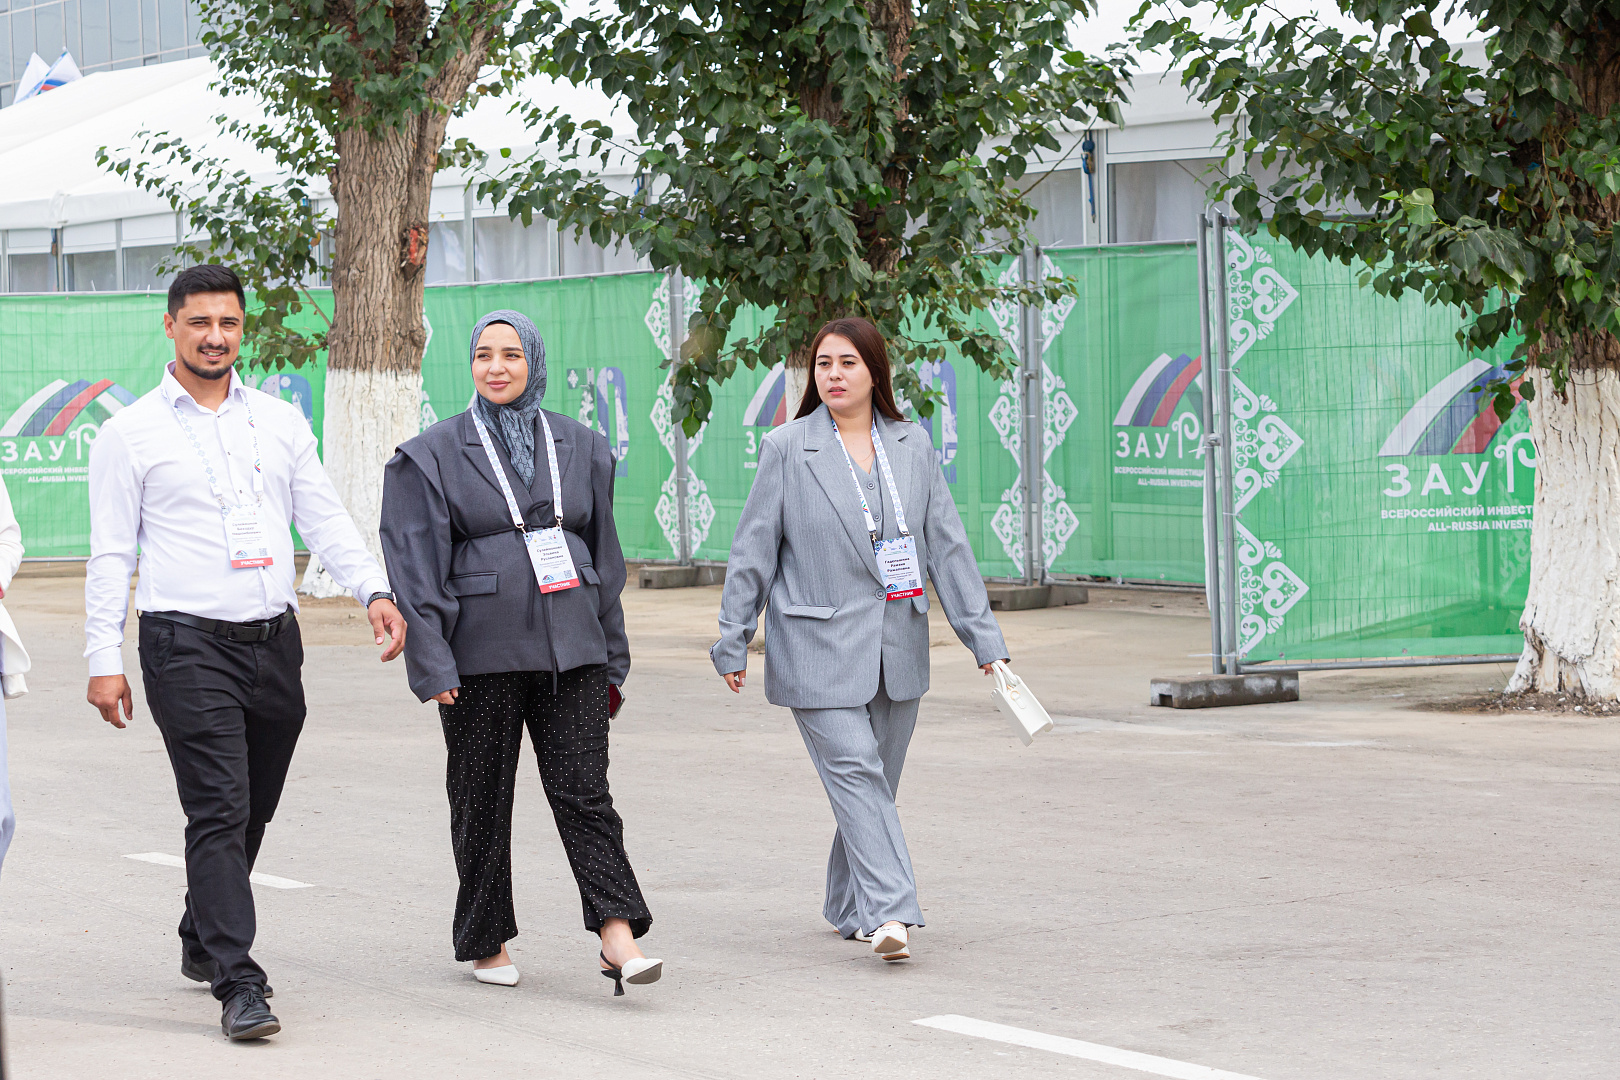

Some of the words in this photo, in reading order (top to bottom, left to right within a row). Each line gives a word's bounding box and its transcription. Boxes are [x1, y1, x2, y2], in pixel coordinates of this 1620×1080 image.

[1, 423, 100, 462] ЗАУР
[1115, 411, 1205, 460] ЗАУРА
[64, 466, 89, 474] ИНВЕС
[1383, 432, 1537, 498] ЗАУР
[1381, 504, 1485, 519] ВСЕРОССИЙСКИЙ
[1487, 504, 1534, 516] ИНВЕСТ
[1428, 520, 1490, 532] ALL-RUSSIA
[1491, 518, 1533, 530] INVEST
